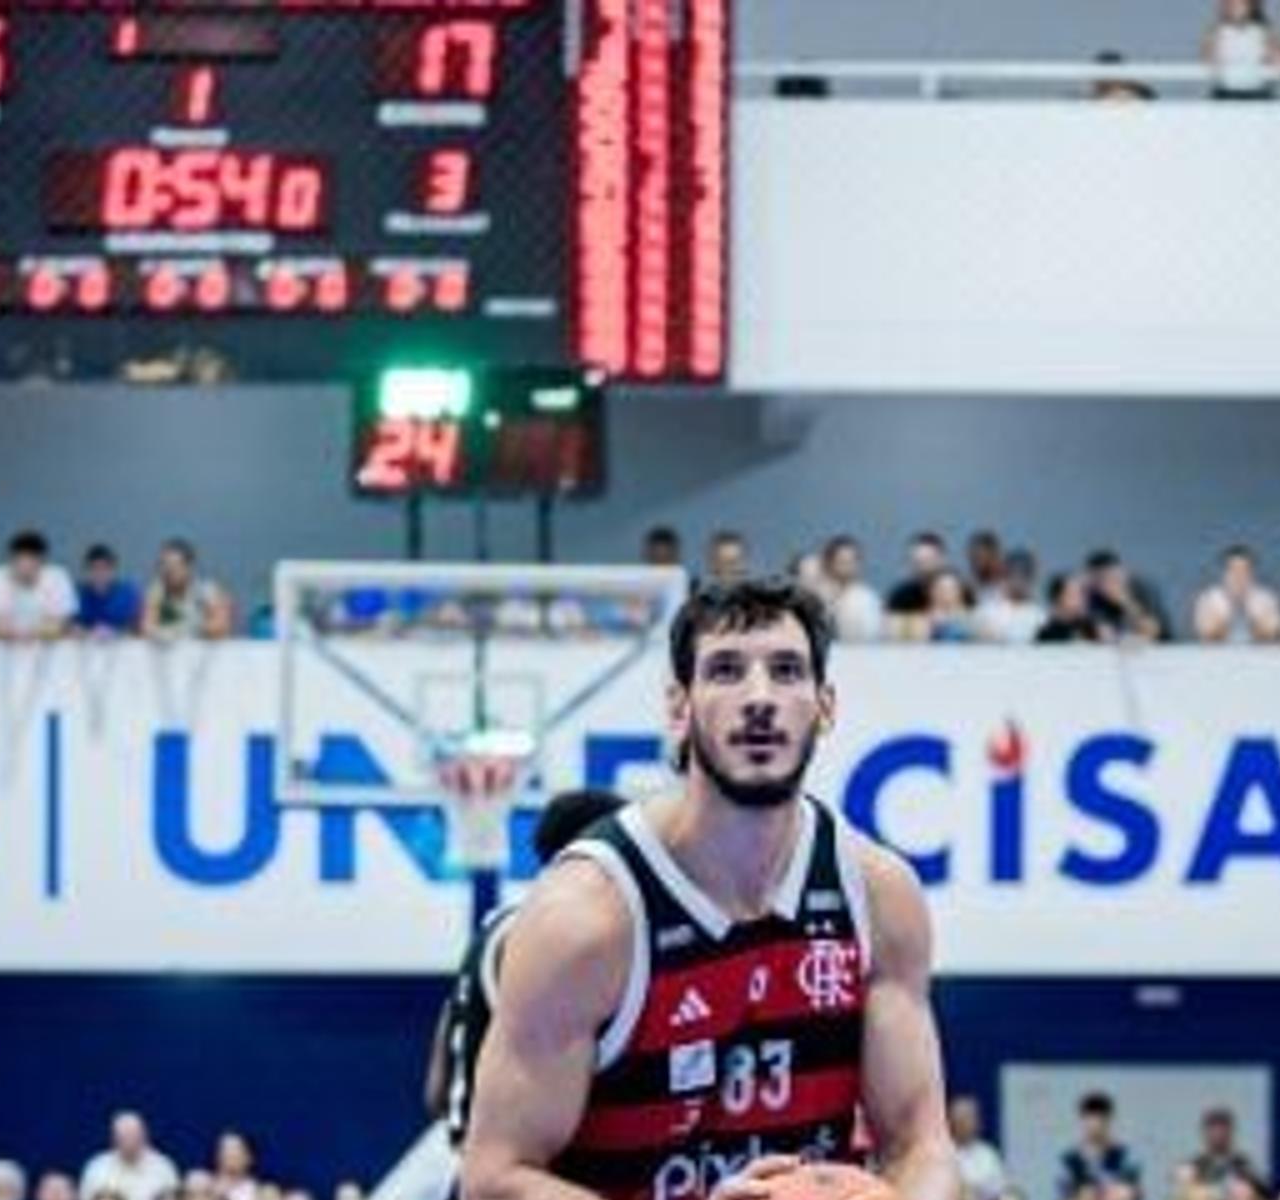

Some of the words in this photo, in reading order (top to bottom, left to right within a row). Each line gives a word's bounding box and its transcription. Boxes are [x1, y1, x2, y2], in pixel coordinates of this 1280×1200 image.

[419, 21, 494, 95] 17
[189, 69, 212, 121] 1
[428, 150, 468, 211] 3
[358, 418, 459, 487] 24
[723, 1039, 792, 1115] 83
